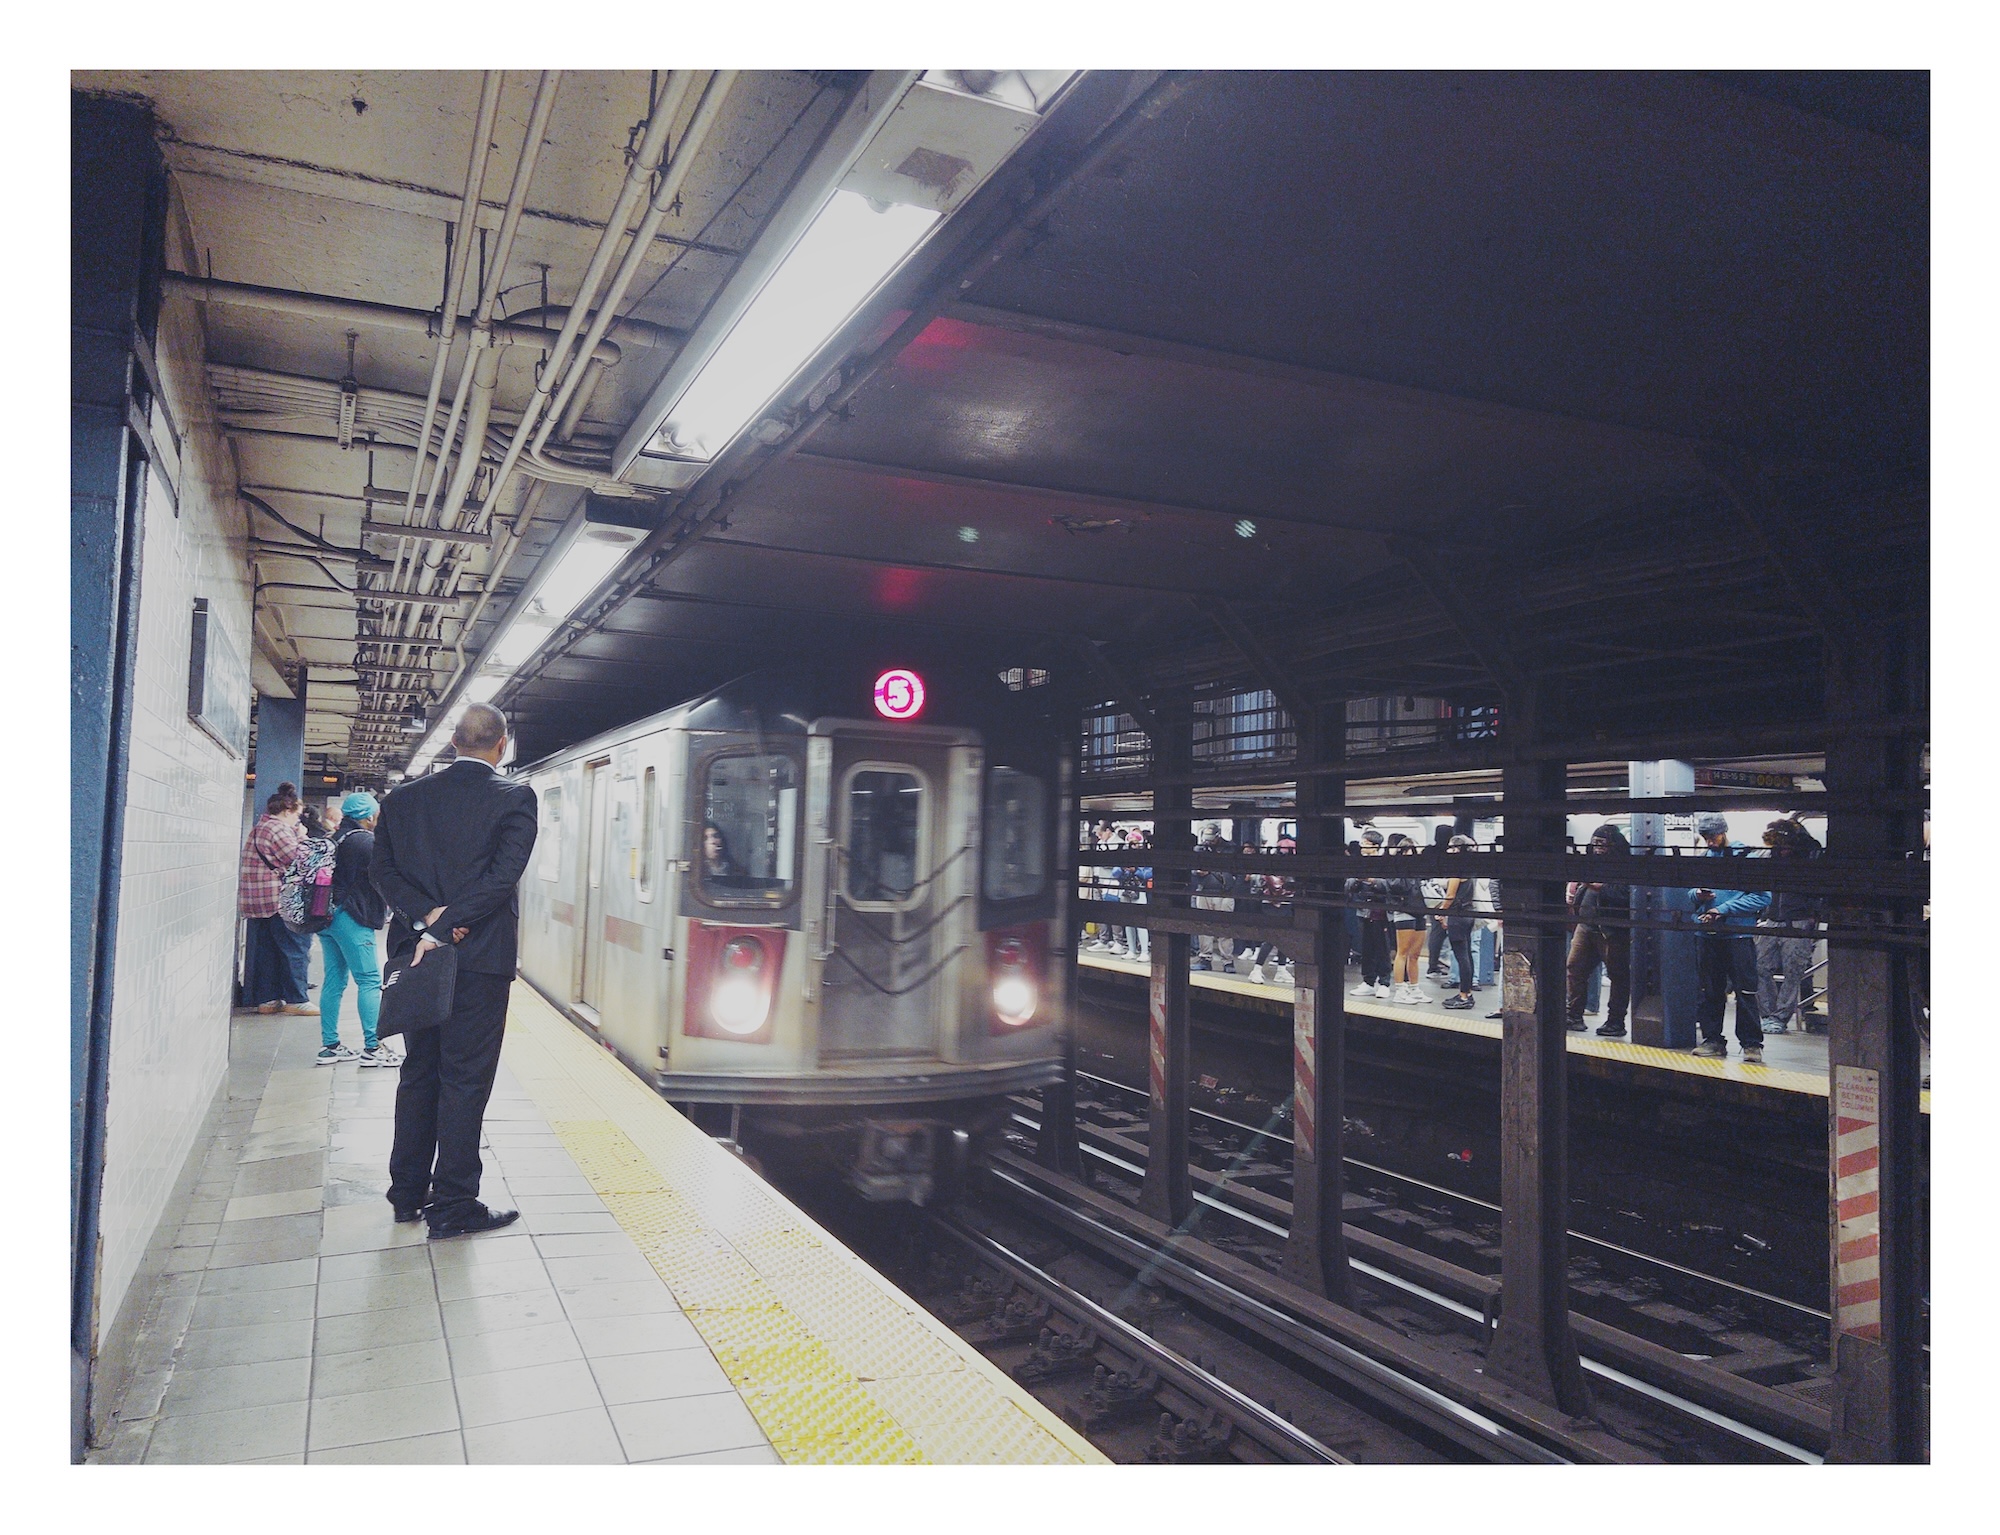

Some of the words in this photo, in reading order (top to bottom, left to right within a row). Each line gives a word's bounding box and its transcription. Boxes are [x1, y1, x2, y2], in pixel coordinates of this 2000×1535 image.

[888, 679, 911, 710] 5
[1664, 813, 1694, 826] Street
[1837, 1081, 1879, 1095] CLEARANCE
[1841, 1091, 1875, 1104] BETWEEN
[1841, 1101, 1875, 1114] COLUMNS
